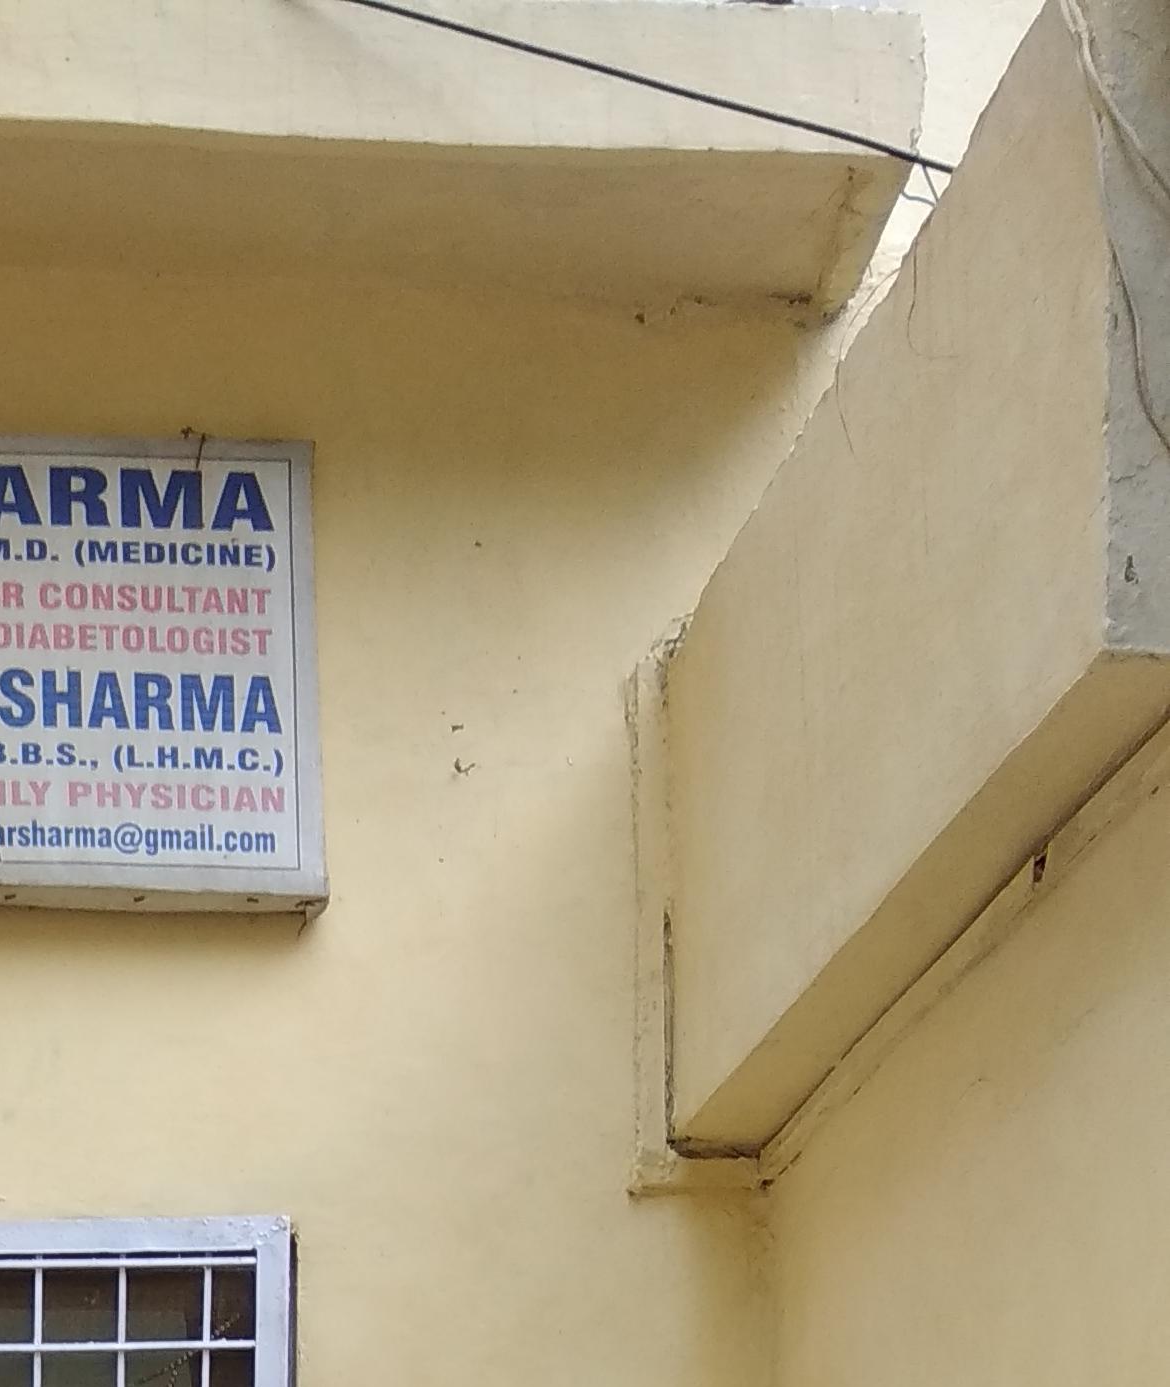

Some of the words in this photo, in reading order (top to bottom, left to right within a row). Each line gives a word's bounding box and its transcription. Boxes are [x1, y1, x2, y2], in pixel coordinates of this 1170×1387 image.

[74, 539, 276, 572] (MEDICINE)
[38, 581, 272, 616] CONSULTANT
[113, 745, 284, 777] (L.H.M.C.)
[68, 783, 285, 813] PHYSICIAN
